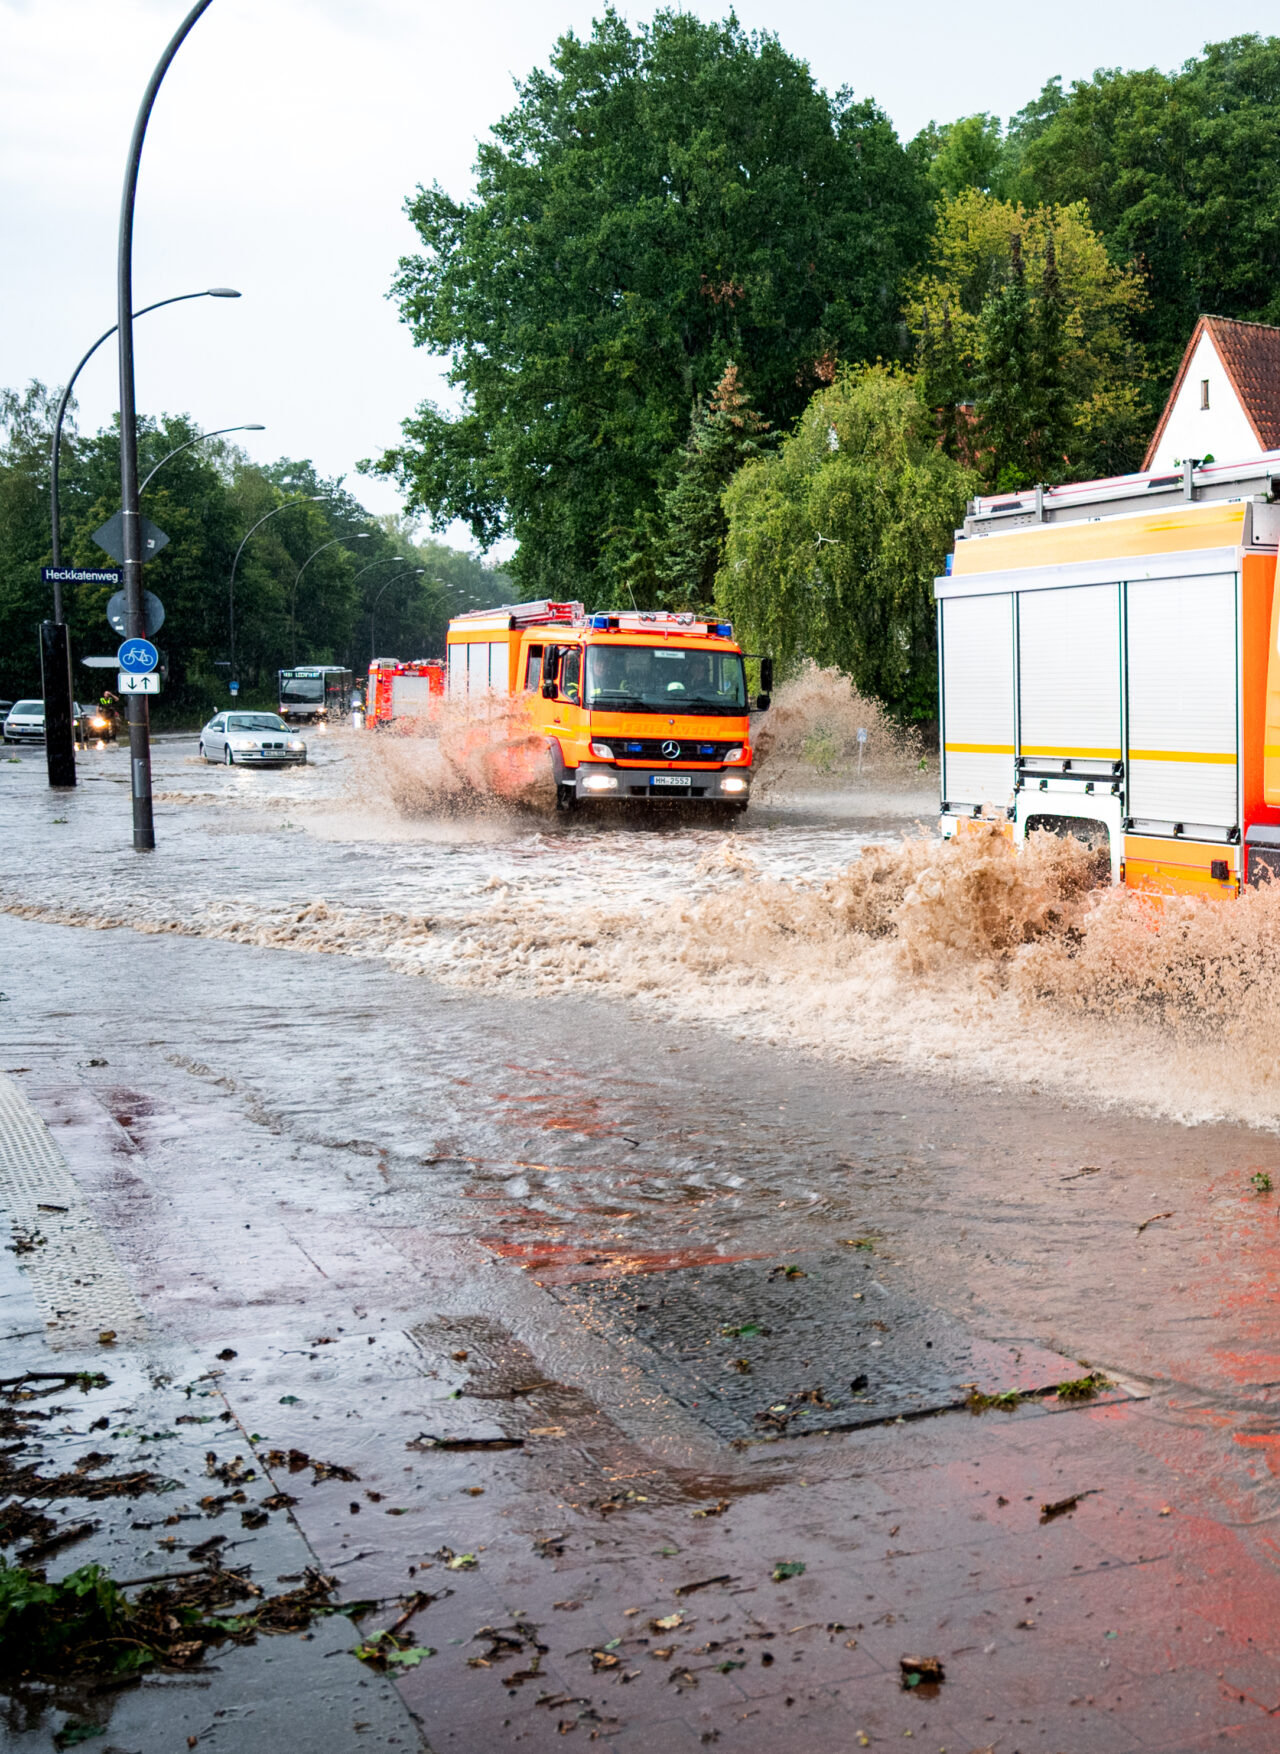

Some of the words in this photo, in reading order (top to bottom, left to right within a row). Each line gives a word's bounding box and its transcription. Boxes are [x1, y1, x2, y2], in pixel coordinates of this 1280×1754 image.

[45, 569, 119, 584] Heckkatenweg
[621, 722, 720, 737] FEUERWEHR
[670, 777, 690, 785] 2552
